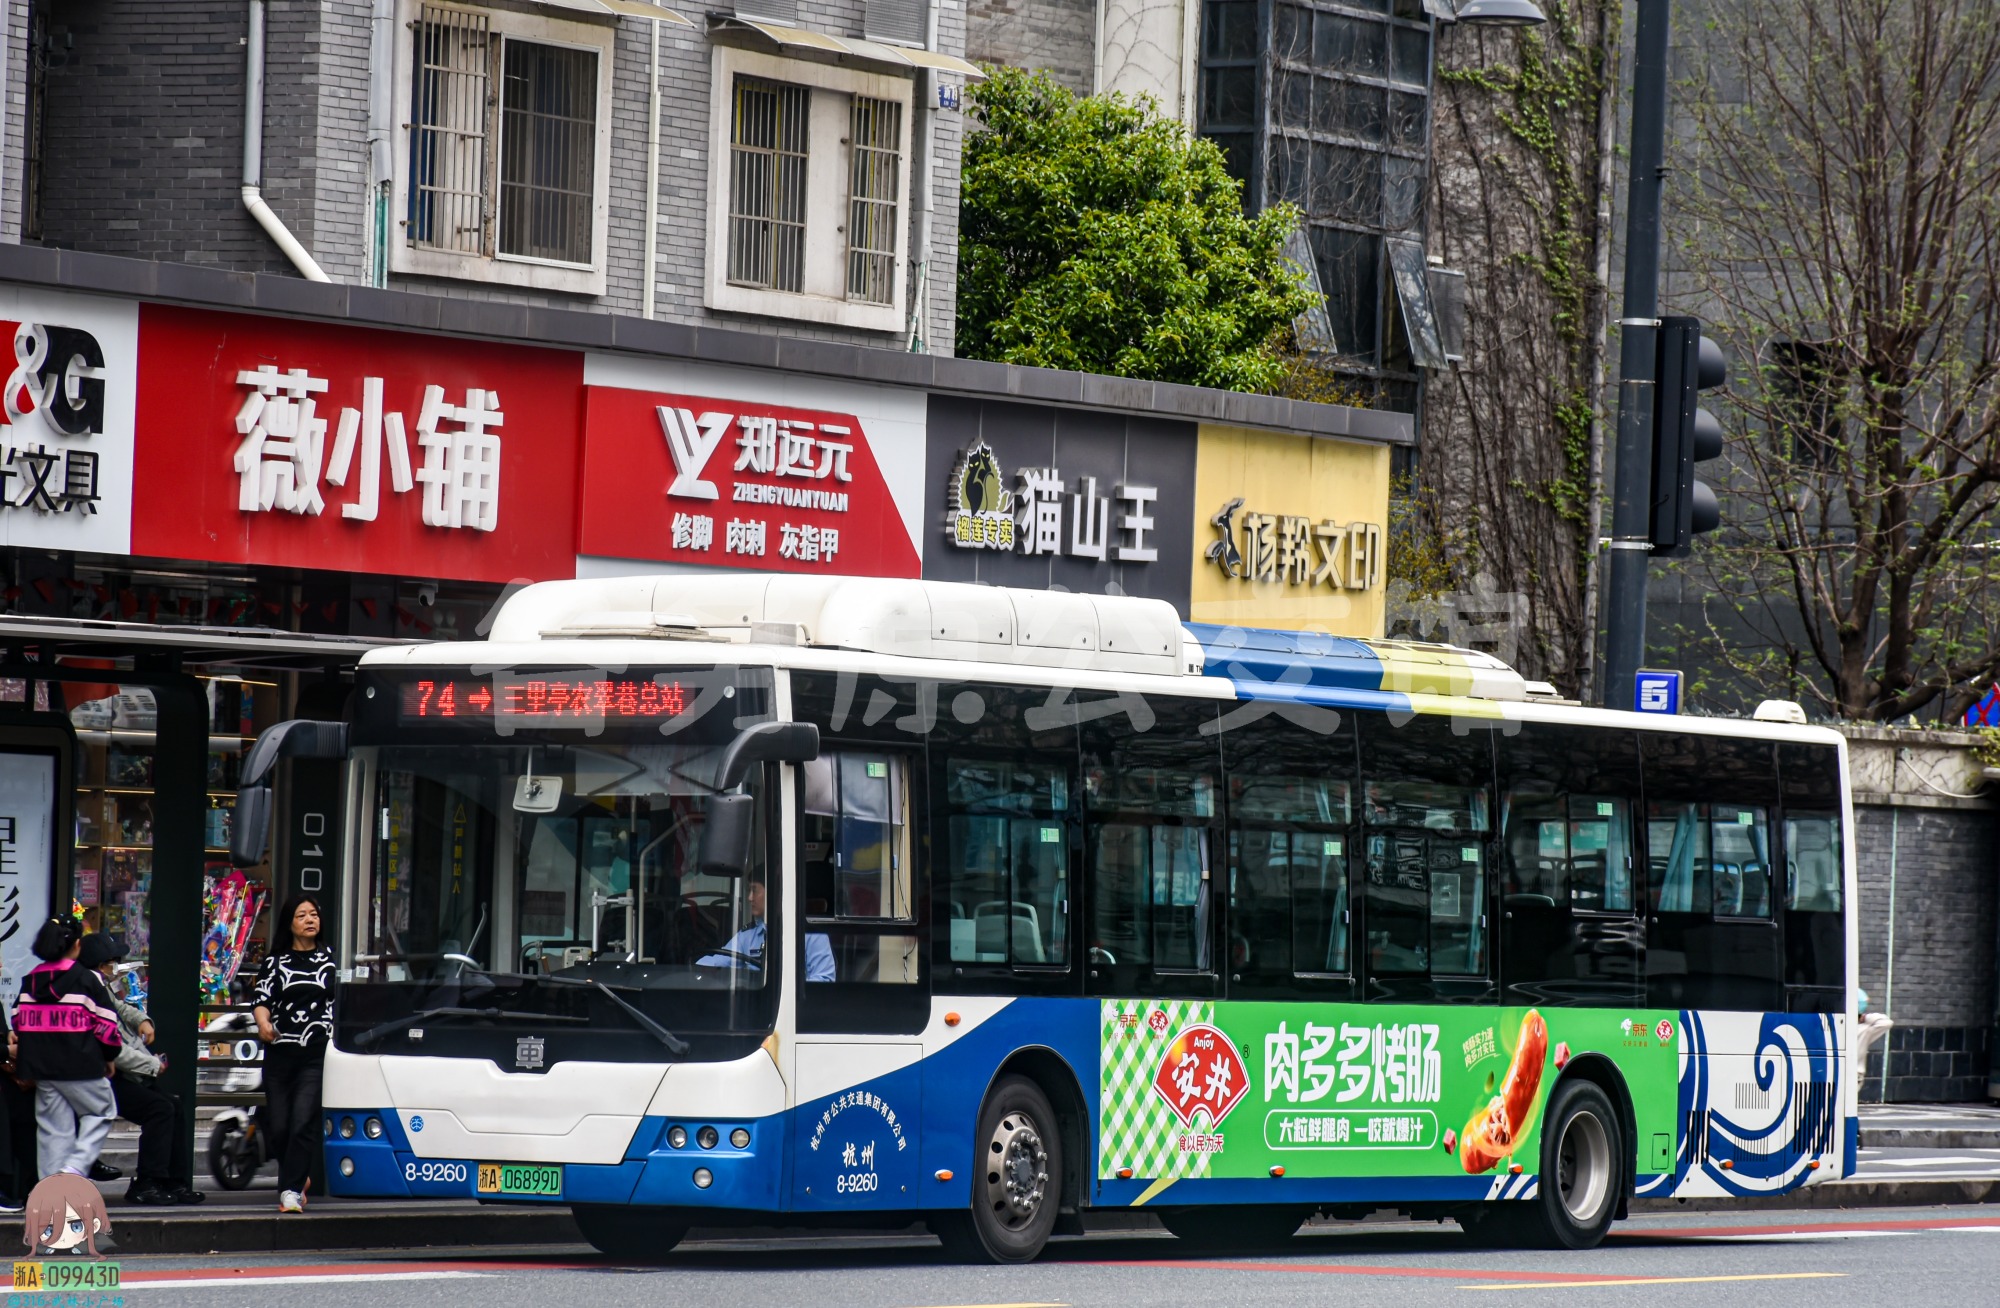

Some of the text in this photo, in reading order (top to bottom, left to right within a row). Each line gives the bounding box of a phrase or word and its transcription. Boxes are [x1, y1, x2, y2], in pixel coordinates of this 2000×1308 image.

[0, 320, 105, 434] &G
[234, 365, 504, 532] 薇小铺
[734, 415, 853, 482] 郑远元
[733, 482, 848, 512] ZHENGYUANYUAN
[956, 515, 1014, 545] 榴莲专卖
[1015, 467, 1158, 562] 猫山王
[671, 512, 839, 562] 修脚 肉刺 灰指甲
[1241, 511, 1381, 591] 杨羚文印
[418, 681, 455, 716] 74
[1119, 1014, 1138, 1028] 京东
[1633, 1023, 1647, 1036] 京东
[1194, 1033, 1214, 1050] Anjoy
[1264, 1021, 1441, 1103] 肉多多烤肠
[1171, 1052, 1231, 1109] 安井
[810, 1091, 907, 1151] 杭州市公共交通集团有限公司
[1279, 1117, 1424, 1142] 大粒鲜腿肉 一咬就爆汁
[842, 1140, 875, 1171] 杭州
[1178, 1134, 1224, 1152] 食以民为天
[405, 1163, 467, 1182] 8-9260
[837, 1173, 878, 1193] 8-9260
